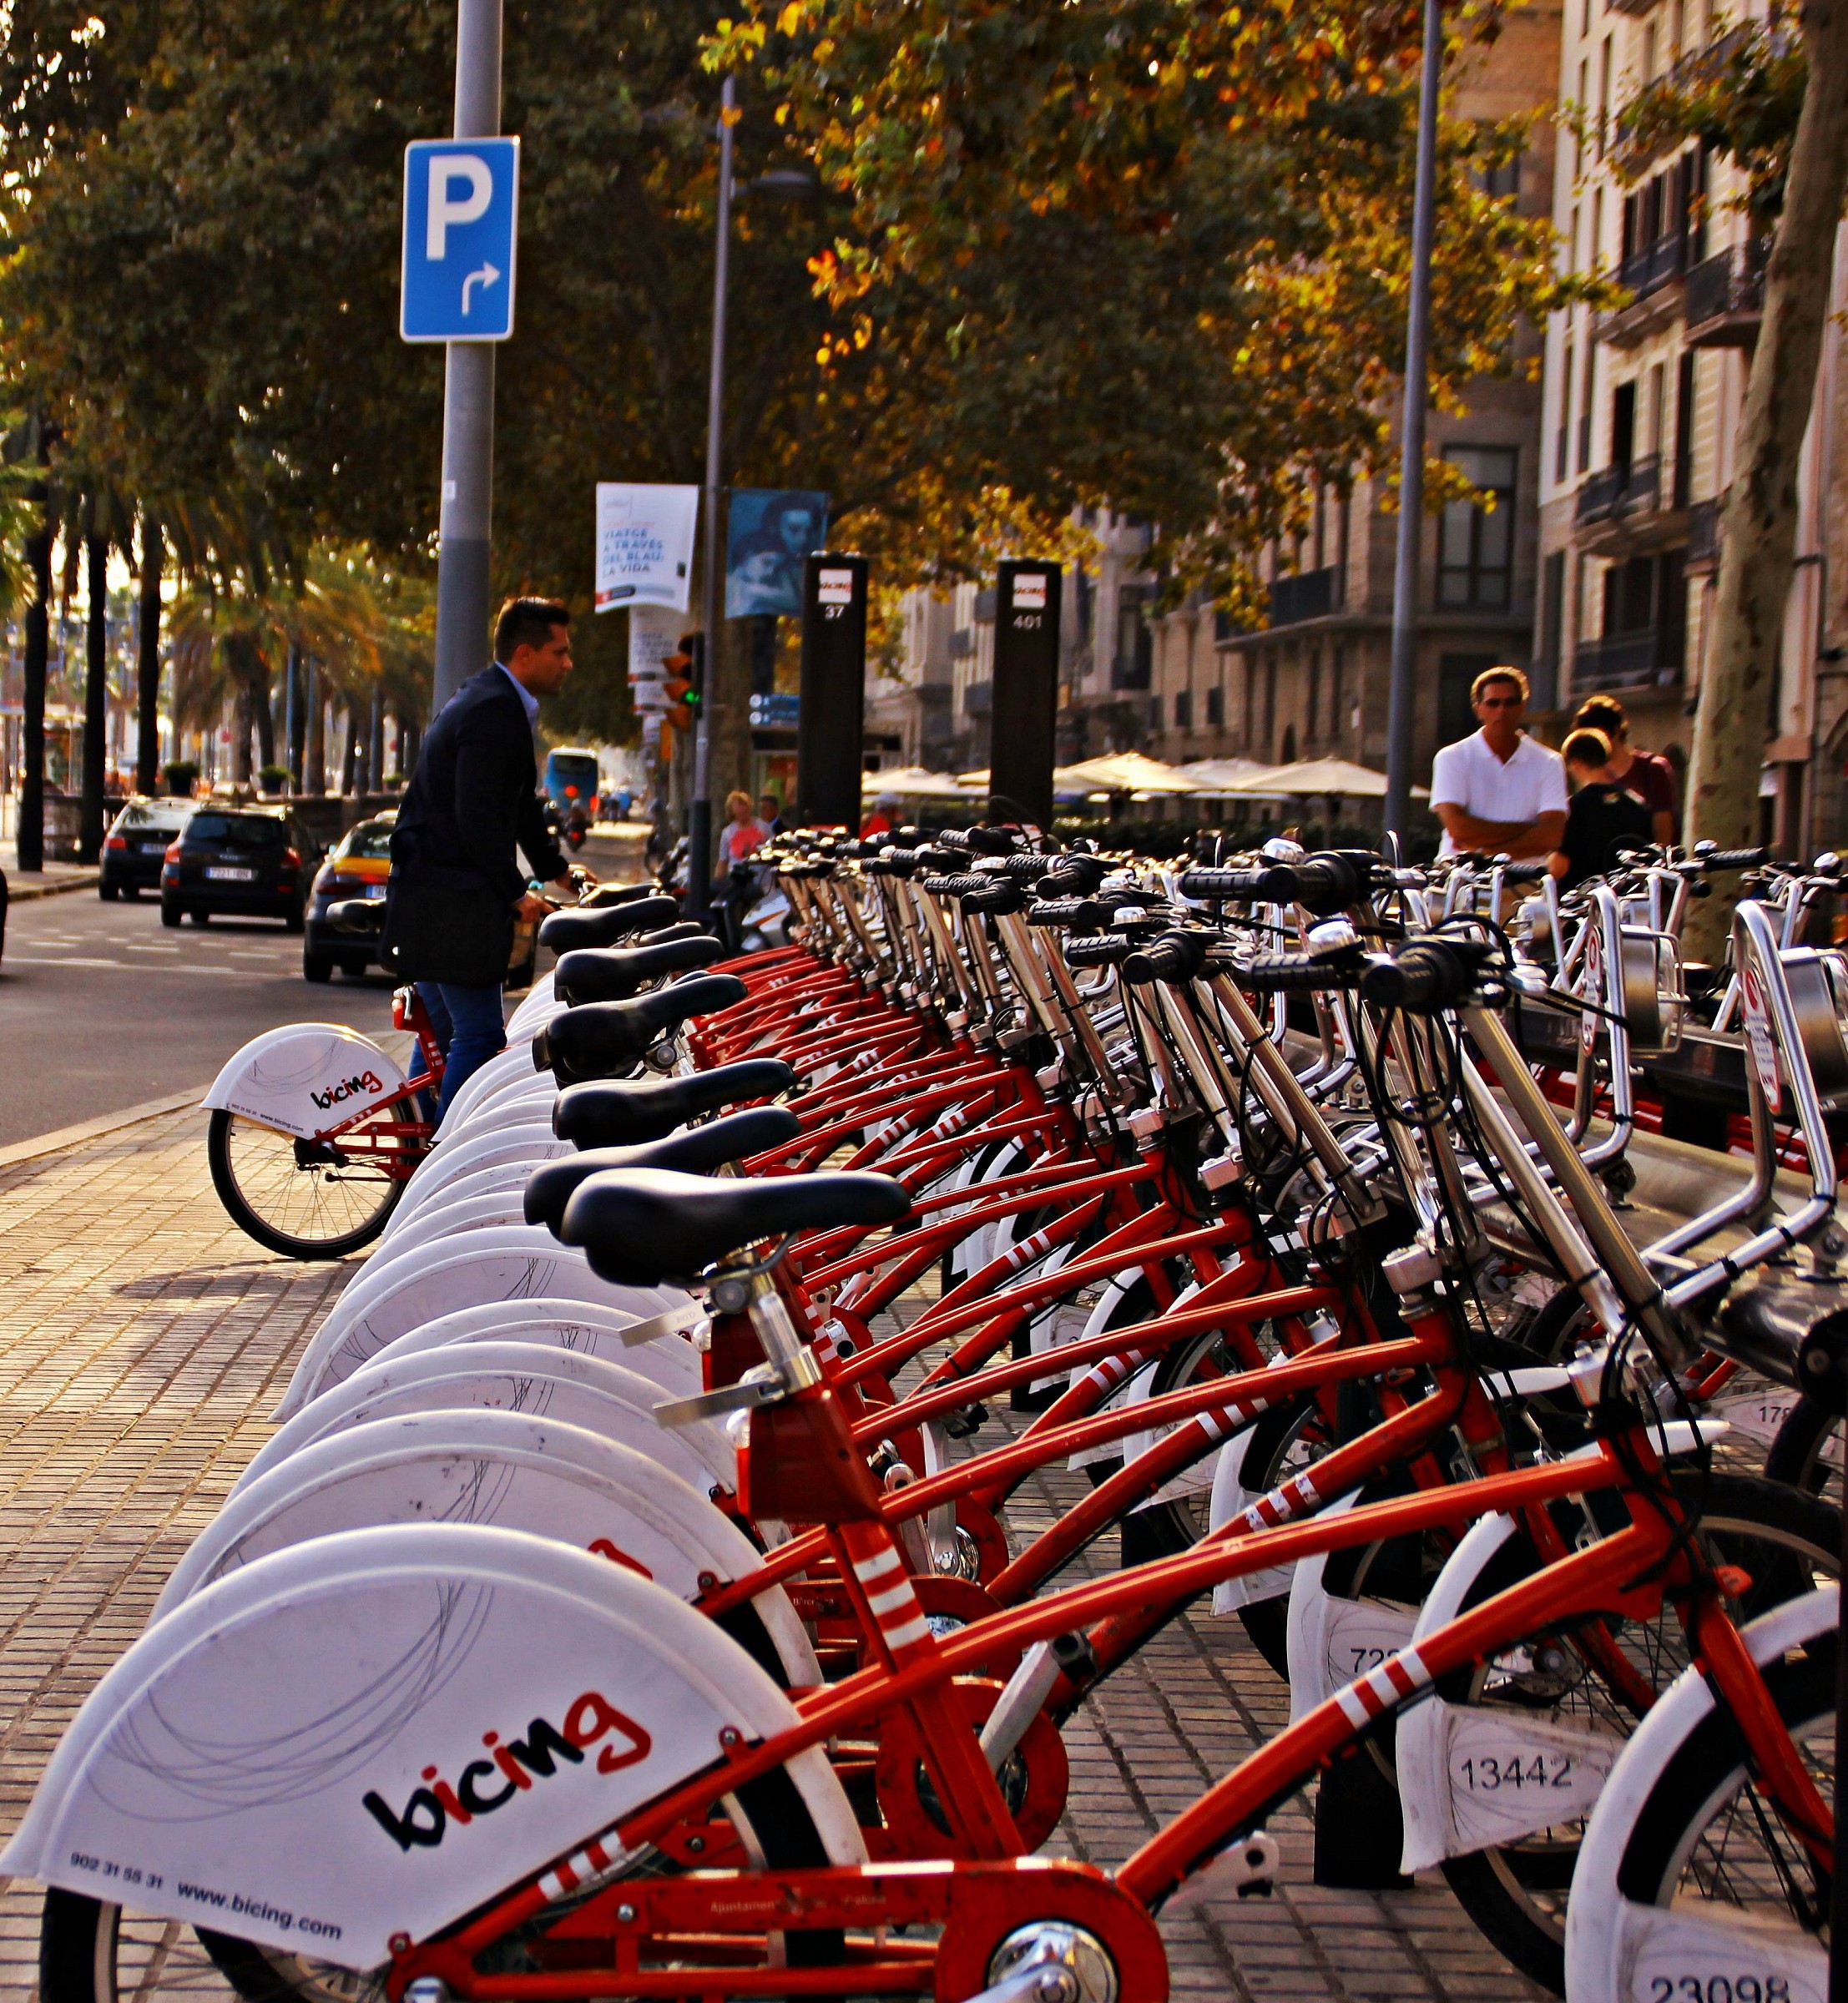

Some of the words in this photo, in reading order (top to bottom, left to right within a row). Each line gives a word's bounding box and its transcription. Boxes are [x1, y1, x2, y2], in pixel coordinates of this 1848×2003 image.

[426, 154, 492, 261] P
[825, 605, 845, 619] 37
[1013, 613, 1043, 629] 401
[310, 1070, 383, 1110] bicing
[260, 1113, 304, 1133] www.bicing.com
[361, 1691, 652, 1853] bicing
[1460, 1754, 1573, 1792] 13442
[69, 1851, 99, 1873] 902
[102, 1859, 120, 1876] 31
[123, 1866, 142, 1884] 55
[145, 1873, 164, 1889] 31
[177, 1879, 343, 1940] www.bicing.com
[1651, 1975, 1791, 2003] 23098
